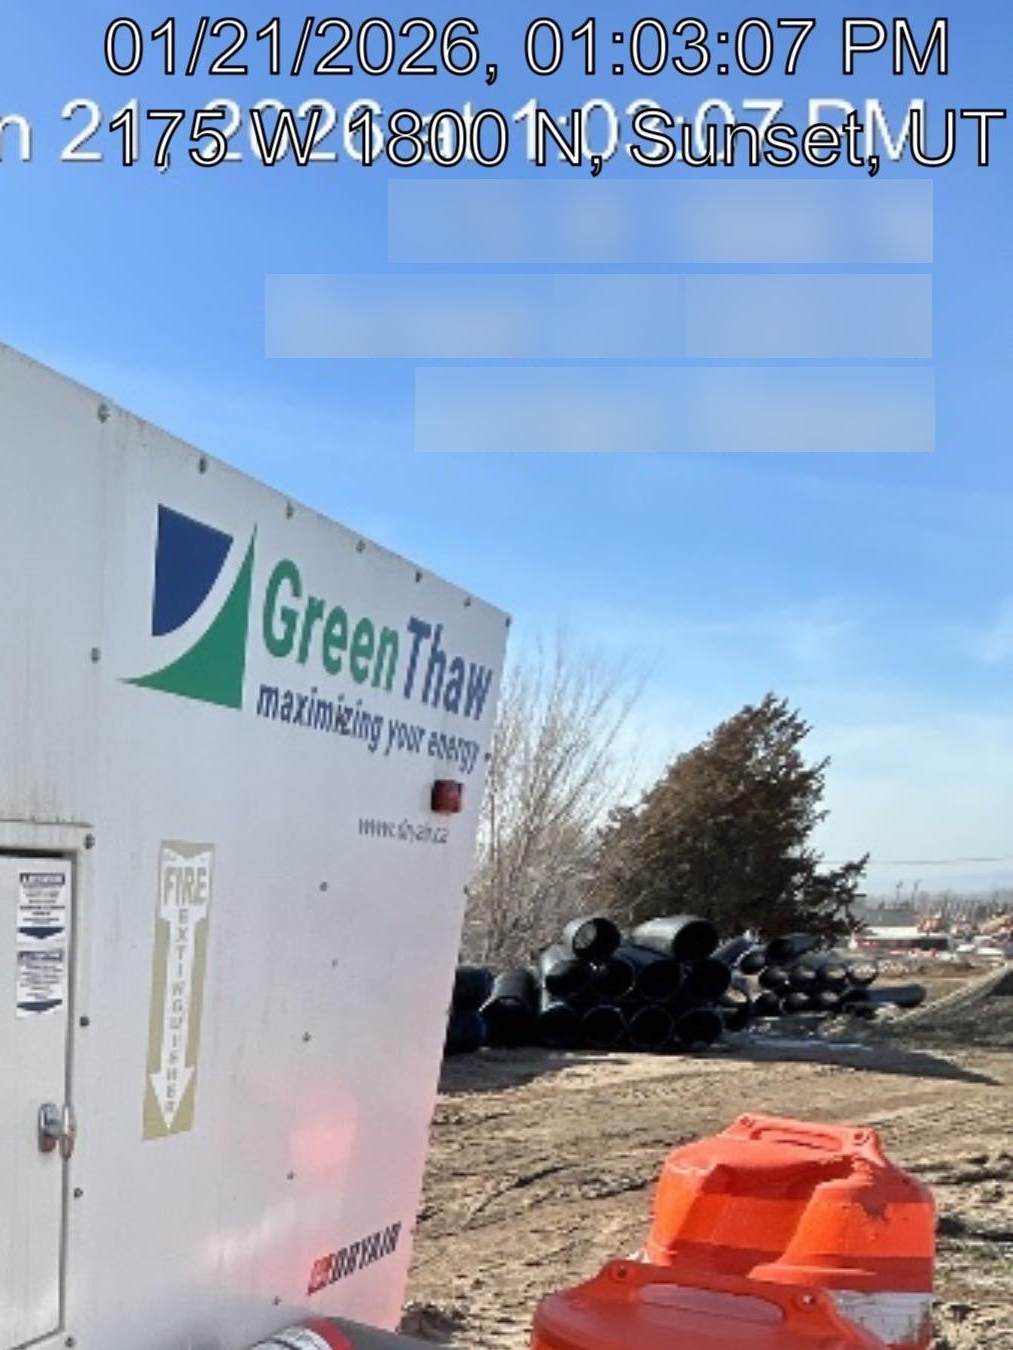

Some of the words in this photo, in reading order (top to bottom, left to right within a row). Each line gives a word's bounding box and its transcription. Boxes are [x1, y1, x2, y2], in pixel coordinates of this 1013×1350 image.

[256, 683, 384, 753] maximizing
[384, 719, 426, 756] your
[428, 731, 480, 775] energy
[163, 866, 208, 906] FIRE
